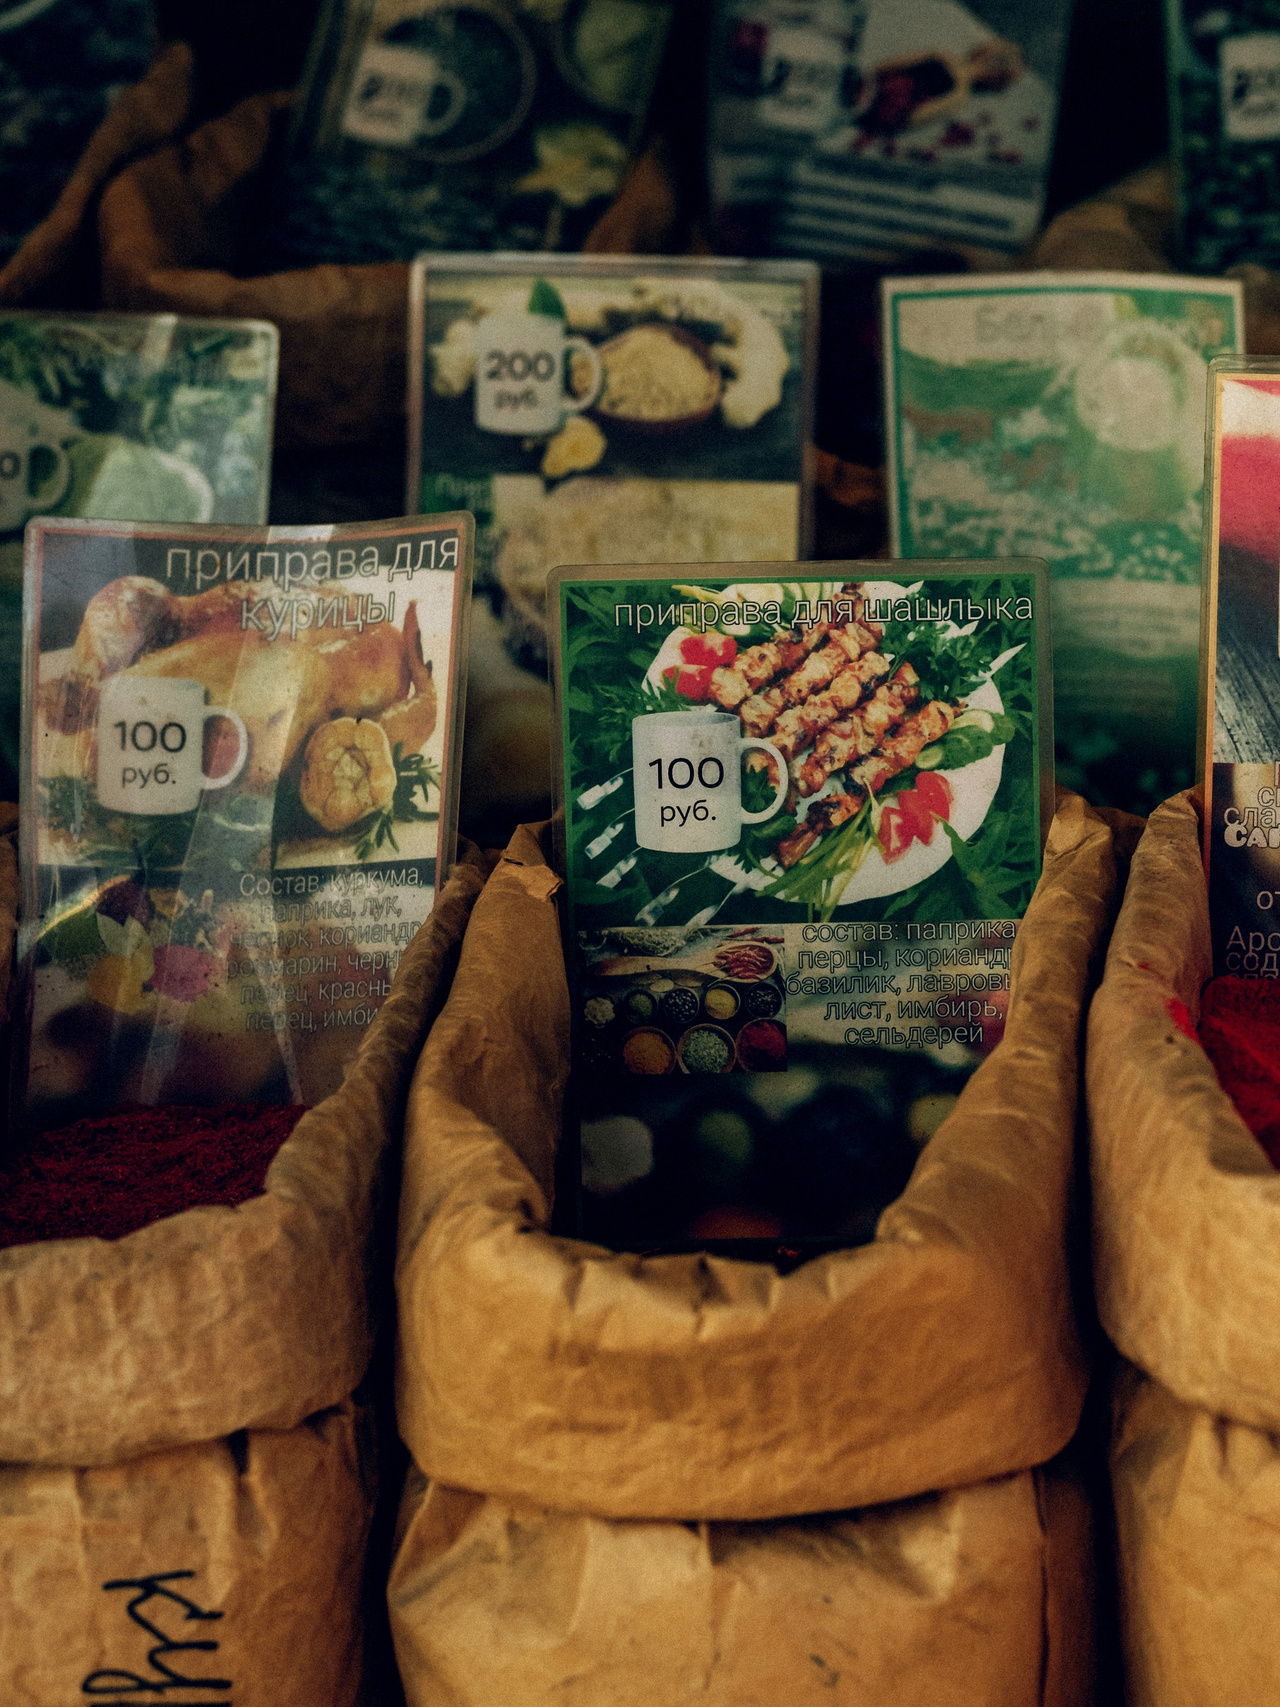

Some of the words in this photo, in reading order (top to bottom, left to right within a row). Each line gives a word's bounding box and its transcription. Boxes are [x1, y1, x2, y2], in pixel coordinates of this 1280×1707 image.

[486, 348, 555, 382] 200
[166, 545, 380, 592] приправа
[388, 536, 460, 581] для
[240, 591, 396, 641] курицы
[614, 599, 782, 633] приправа
[791, 599, 855, 629] для
[863, 596, 1034, 623] шашлыка
[114, 721, 187, 752] 100
[122, 763, 176, 788] руб.
[649, 757, 724, 789] 100
[661, 800, 717, 827] руб.
[239, 872, 325, 897] Состав:
[330, 866, 423, 897] куркума,
[361, 895, 403, 922] лук,
[802, 923, 899, 942] состав:
[347, 950, 402, 974] черн
[798, 948, 889, 973] перцы,
[786, 971, 900, 996] базилик,
[824, 1001, 892, 1022] лист,
[897, 995, 1003, 1022] имбирь,
[844, 1022, 984, 1049] сельдерей
